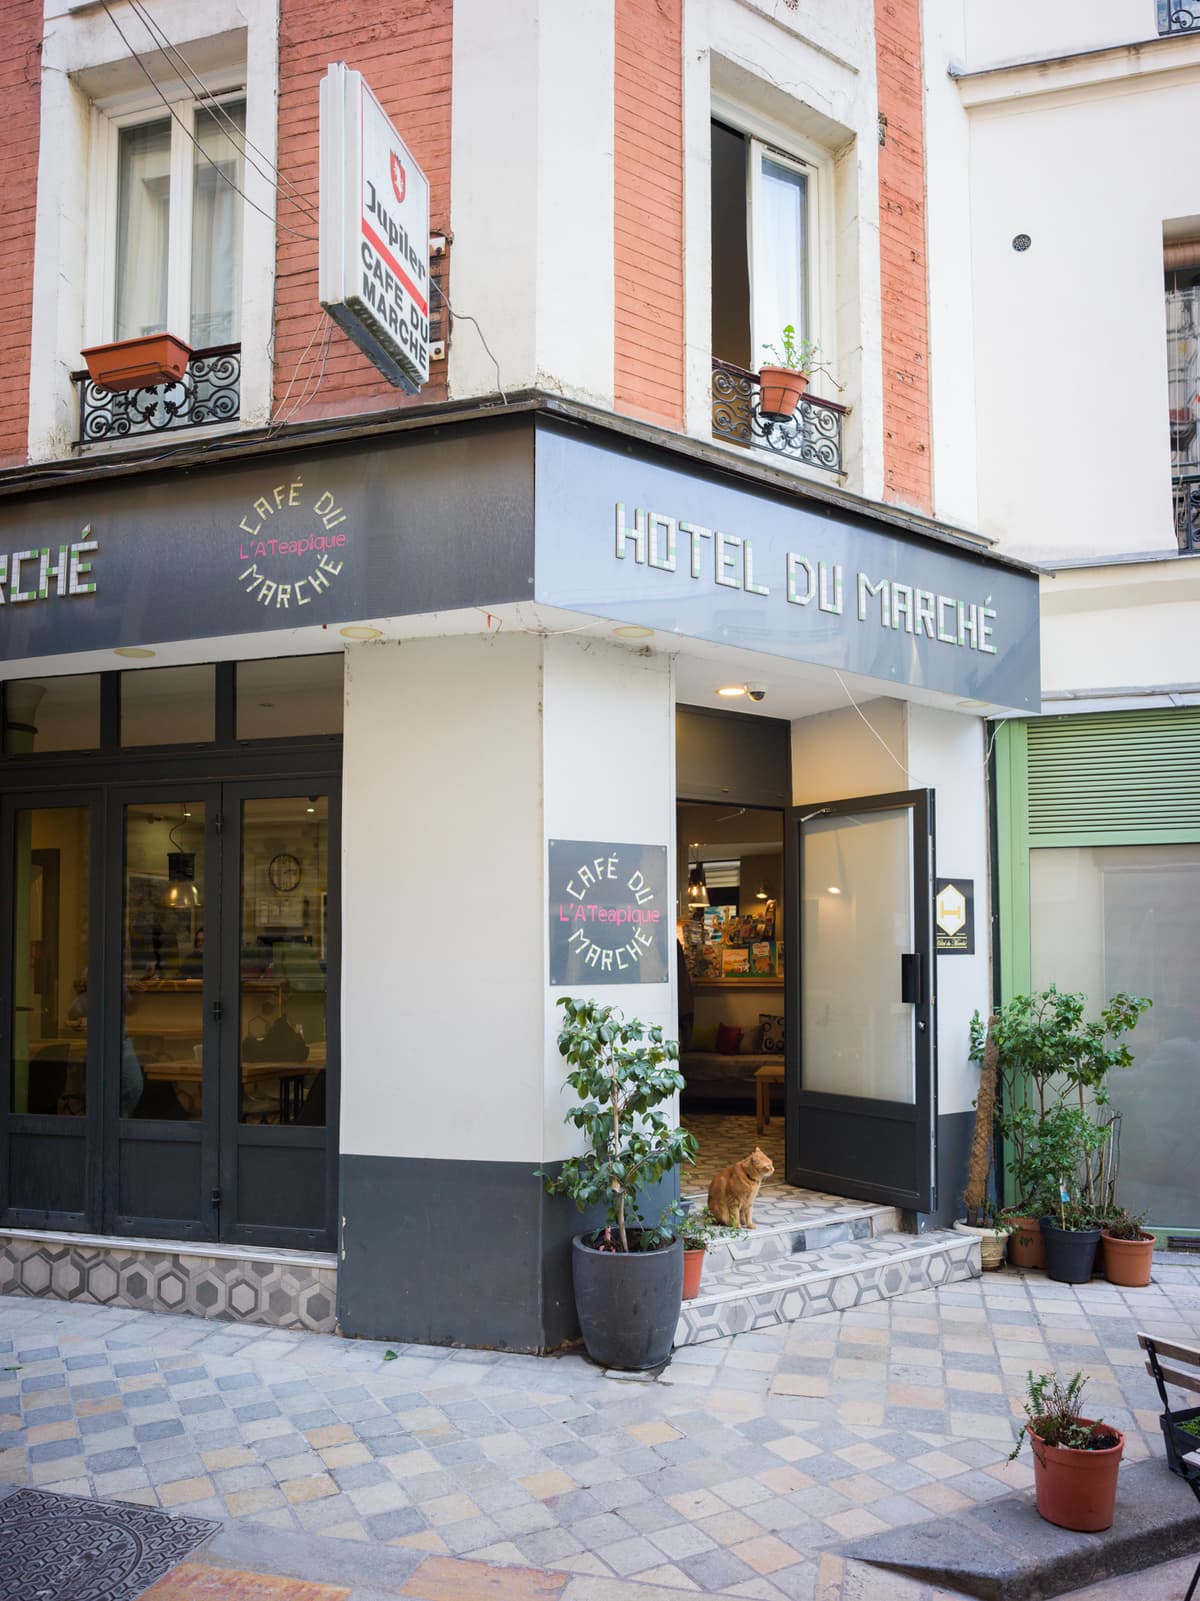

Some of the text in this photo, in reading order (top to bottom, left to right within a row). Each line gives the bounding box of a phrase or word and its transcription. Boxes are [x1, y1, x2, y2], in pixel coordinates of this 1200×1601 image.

[365, 179, 426, 281] Jupiler
[361, 241, 428, 344] CAFE DU
[363, 271, 427, 371] MARCHE
[239, 475, 347, 536] CAFÉ DU
[238, 553, 344, 609] MARCHÉ
[615, 502, 998, 655] HOTEL DU MARCHÉ
[566, 852, 655, 905] CAFÉ DU
[567, 926, 653, 972] MARCHÉ
